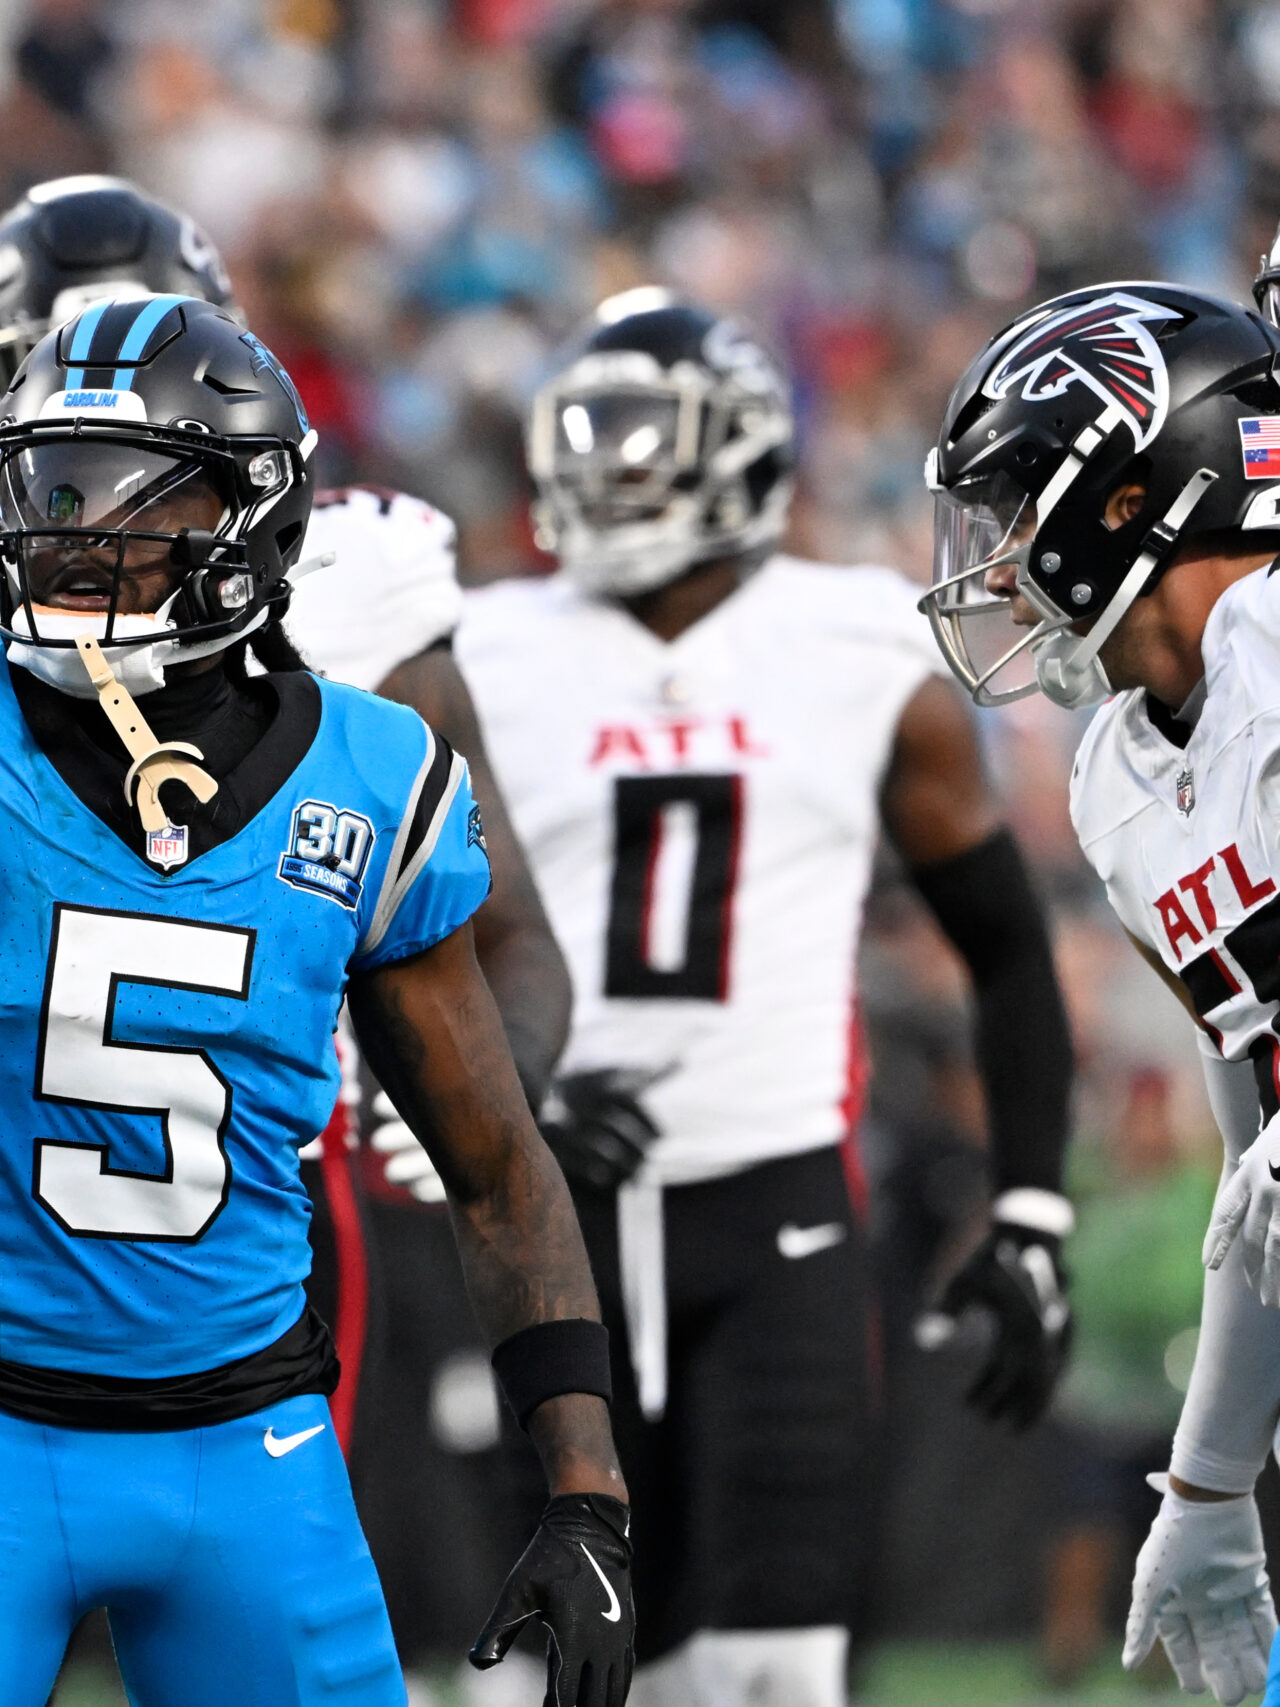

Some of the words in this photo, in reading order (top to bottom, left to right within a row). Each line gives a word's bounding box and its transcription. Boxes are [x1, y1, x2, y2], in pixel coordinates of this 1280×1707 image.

[63, 392, 119, 408] CAROLINA
[588, 711, 773, 770] ATL
[296, 803, 371, 878] 30
[303, 863, 348, 893] SEASONS
[604, 773, 745, 1005] 0
[1153, 843, 1277, 963] ATL
[32, 901, 258, 1244] 5
